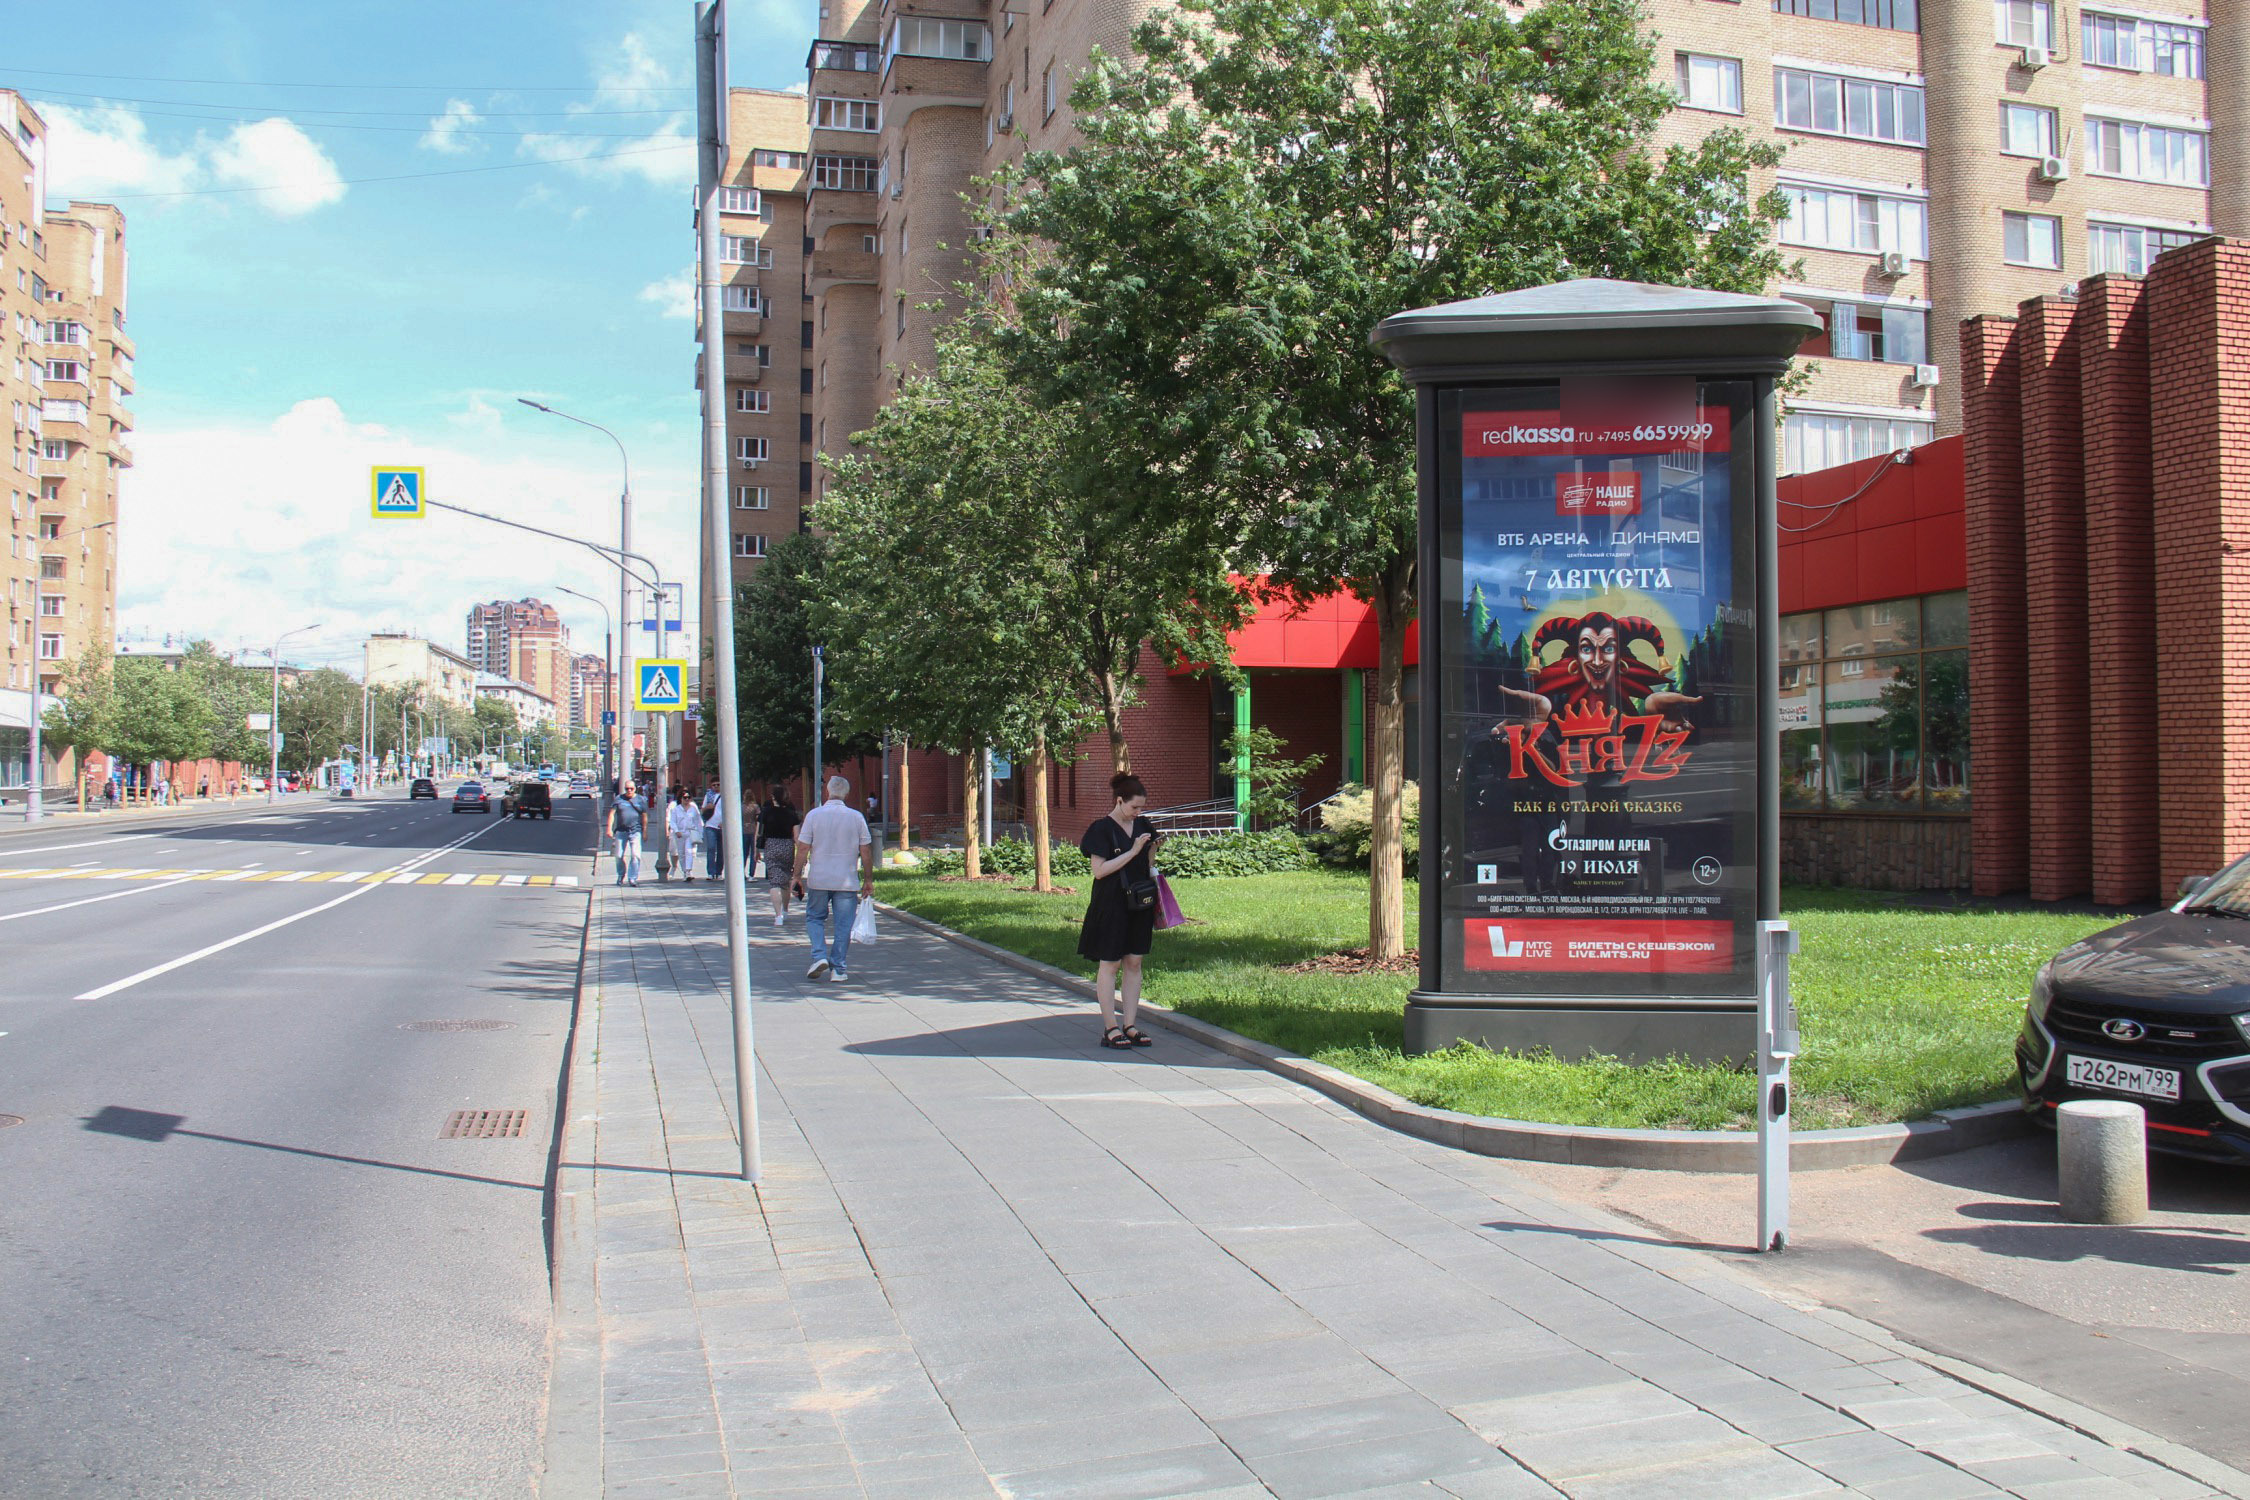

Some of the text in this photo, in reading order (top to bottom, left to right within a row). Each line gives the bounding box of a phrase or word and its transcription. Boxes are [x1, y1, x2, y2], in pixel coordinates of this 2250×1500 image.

[1482, 425, 1594, 445] redkassa.ru
[1597, 431, 1631, 442] +7495
[1596, 485, 1635, 499] НАШЕ
[1596, 500, 1627, 508] РАДИО
[1498, 531, 1700, 546] ВТБ АРЕНА ДИНАМО
[1525, 567, 1673, 595] 7 АВГУСТА
[1513, 799, 1683, 813] КАК В СТАРОЙ СКАЗКЕ
[1568, 839, 1651, 851] ГАЗПРОМ АРЕНА
[1560, 859, 1640, 874] 19 ИЮЛЯ
[1699, 864, 1717, 877] 12+
[1525, 941, 1552, 949] МТС
[1568, 941, 1715, 951] БИЛЕТЫ С КЕШБЭКОМ
[1525, 950, 1552, 958] LIVE
[1568, 950, 1650, 959] LIVE.MTS.RU
[2145, 1068, 2174, 1088] 799
[2151, 1086, 2167, 1095] RUS
